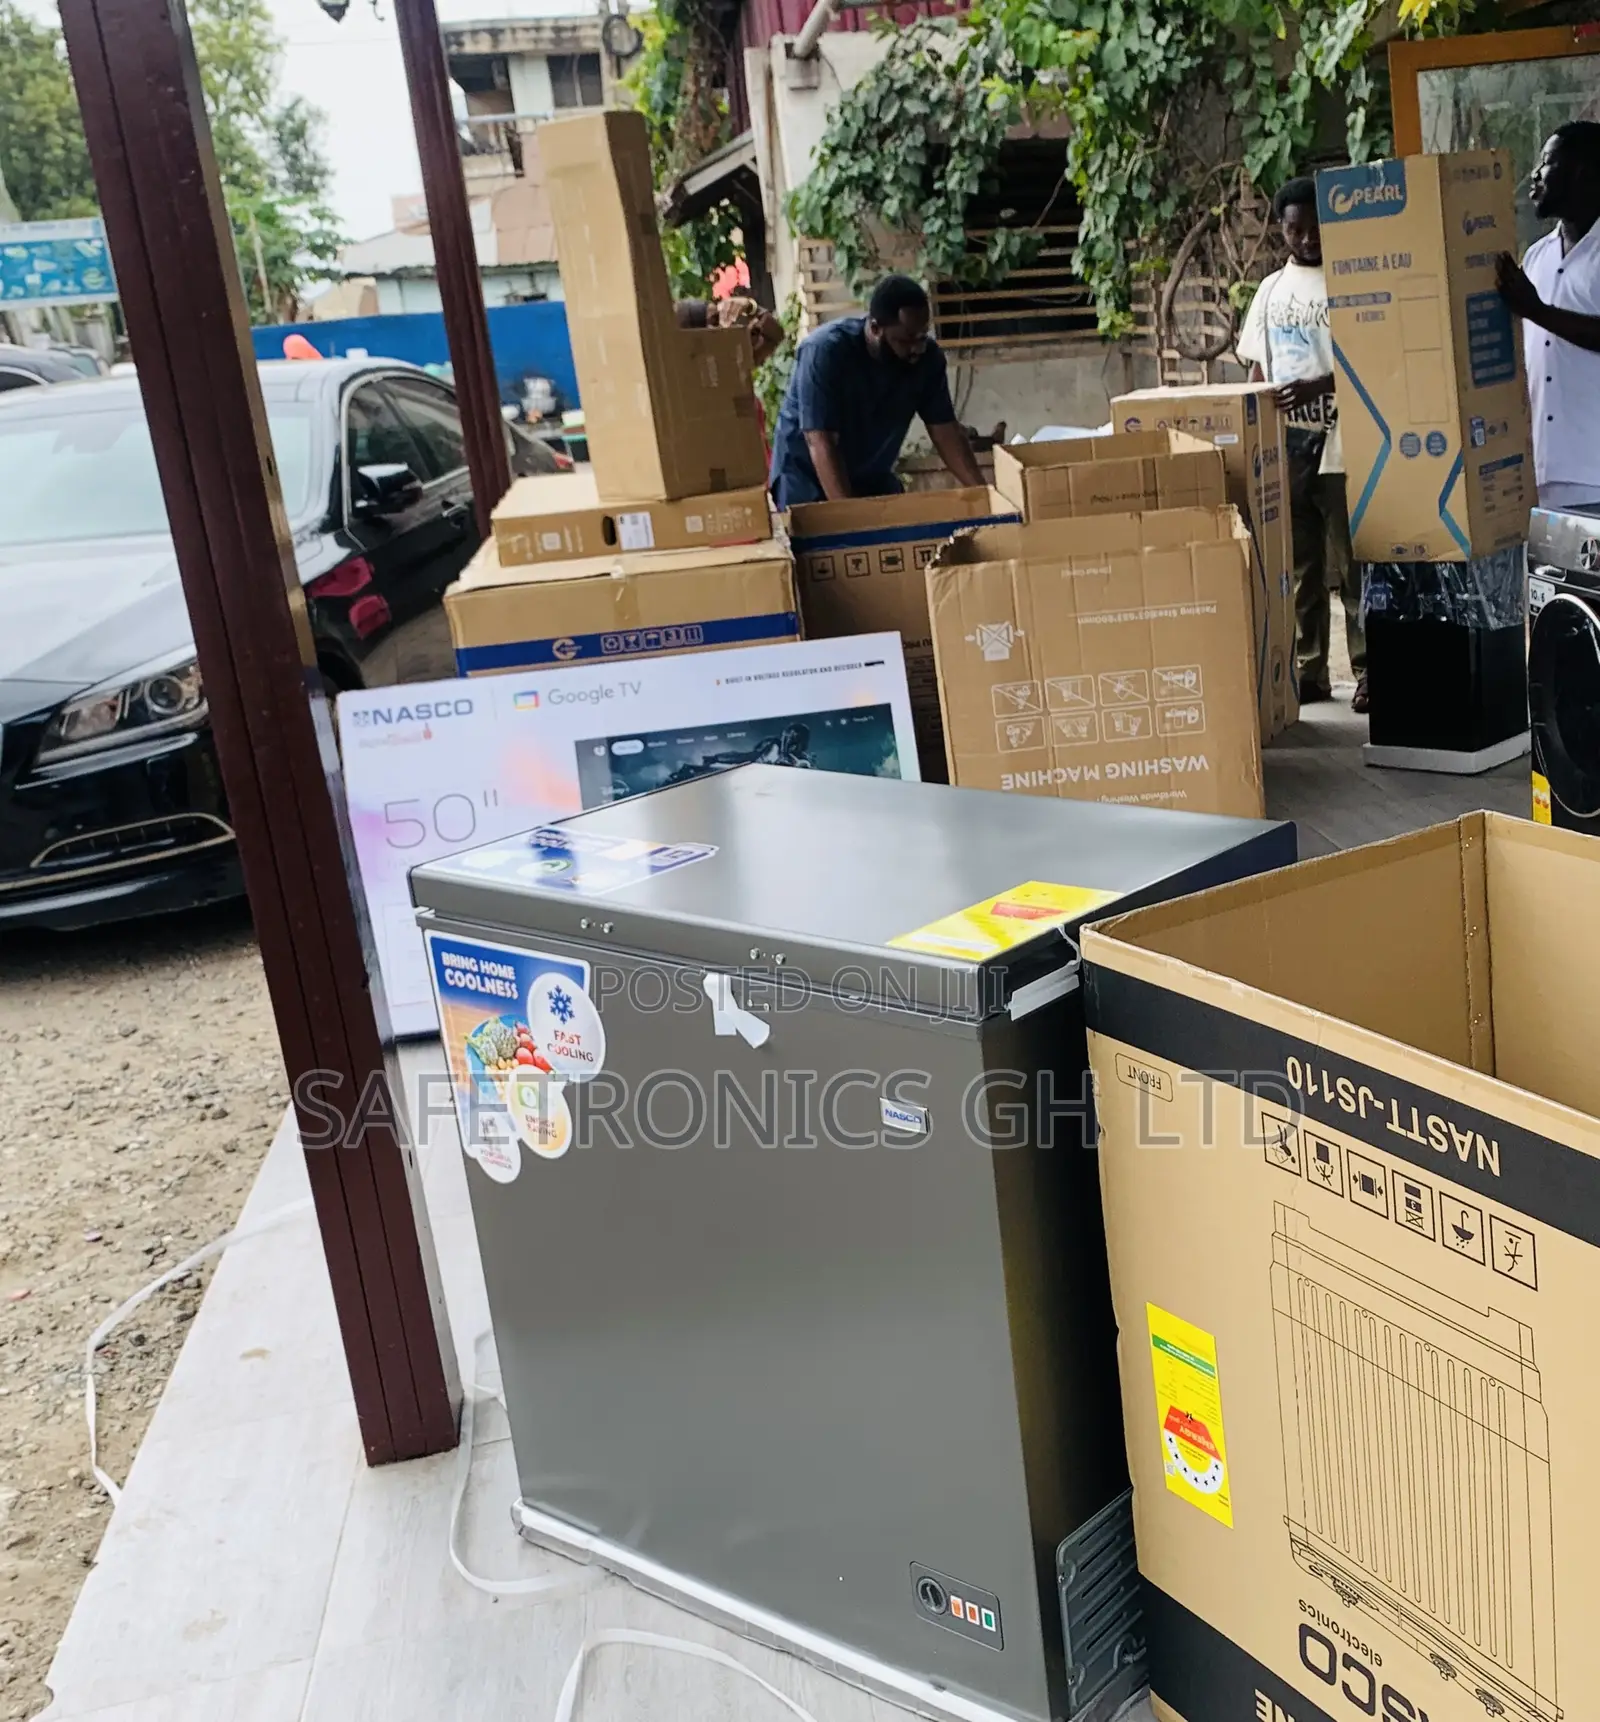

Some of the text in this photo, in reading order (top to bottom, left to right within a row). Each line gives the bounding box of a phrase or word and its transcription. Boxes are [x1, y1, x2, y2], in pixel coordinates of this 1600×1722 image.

[1351, 184, 1404, 206] PEARL
[1332, 256, 1380, 276] FONTAINE
[1391, 252, 1412, 270] EAU
[753, 671, 780, 682] VOLTAGE
[782, 668, 818, 679] REGULATOR
[819, 666, 832, 674] AND
[548, 681, 642, 705] Google TV
[372, 699, 473, 726] NASCO
[1001, 754, 1209, 791] WASHING MACHINE
[1139, 789, 1188, 802] Worldwide
[440, 951, 516, 980] BRING HOME
[445, 967, 519, 1000] COOLNESS
[553, 1029, 582, 1046] FAST
[546, 1042, 594, 1063] COOLING
[1127, 1062, 1163, 1092] FRONT
[525, 1114, 556, 1129] ENERGY
[885, 1107, 922, 1124] NASCO
[1286, 1055, 1501, 1177] NASTT-JS110
[527, 1123, 558, 1139] SAVING
[1299, 1598, 1384, 1668] electronics
